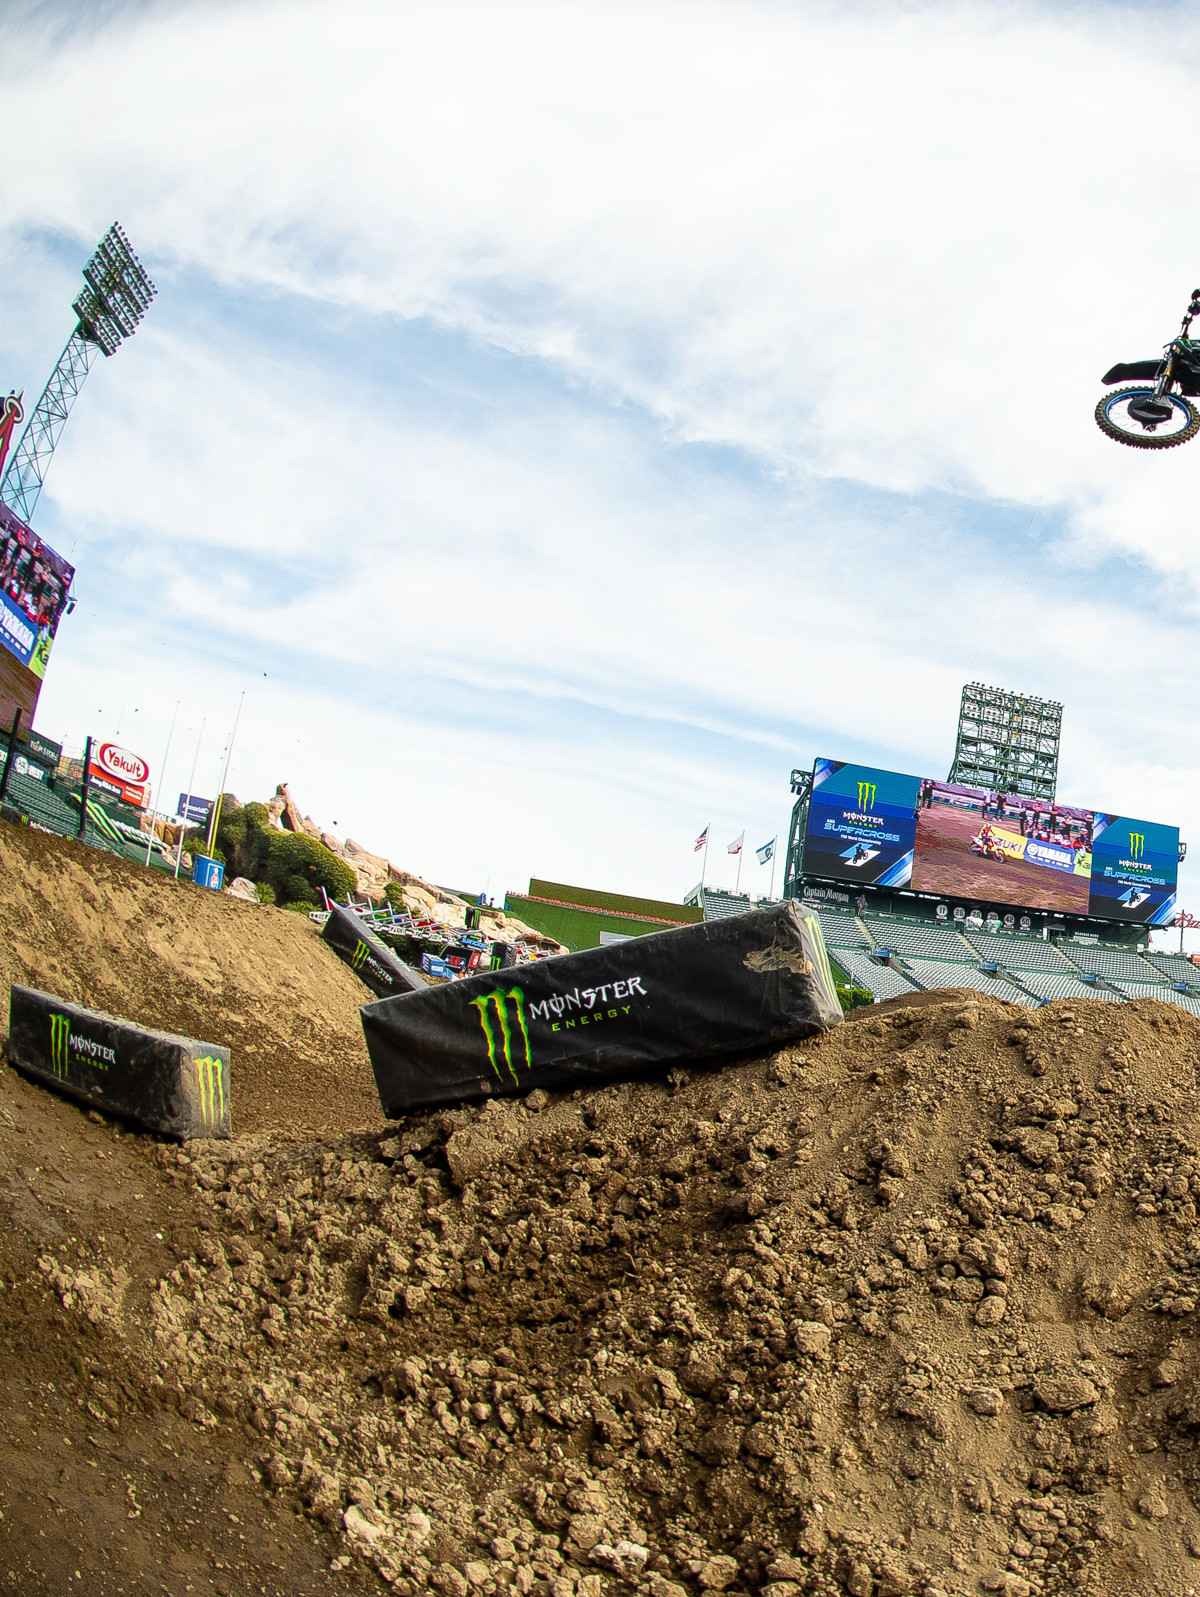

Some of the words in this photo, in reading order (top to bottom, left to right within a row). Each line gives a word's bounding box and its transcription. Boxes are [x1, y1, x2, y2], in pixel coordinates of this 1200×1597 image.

[108, 749, 142, 778] Yakult
[842, 811, 884, 826] MONSTER
[823, 822, 901, 842] SUPERCROSS
[997, 837, 1022, 853] ZUKI
[1118, 859, 1152, 871] MONSTER
[1103, 870, 1166, 886] SUPERCROSS
[803, 885, 826, 899] Captain
[825, 888, 850, 903] Morgan
[528, 976, 648, 1020] MONSTER
[551, 1005, 631, 1032] ENERGY
[69, 1033, 116, 1064] MONSTER
[75, 1053, 109, 1071] ENERGY
